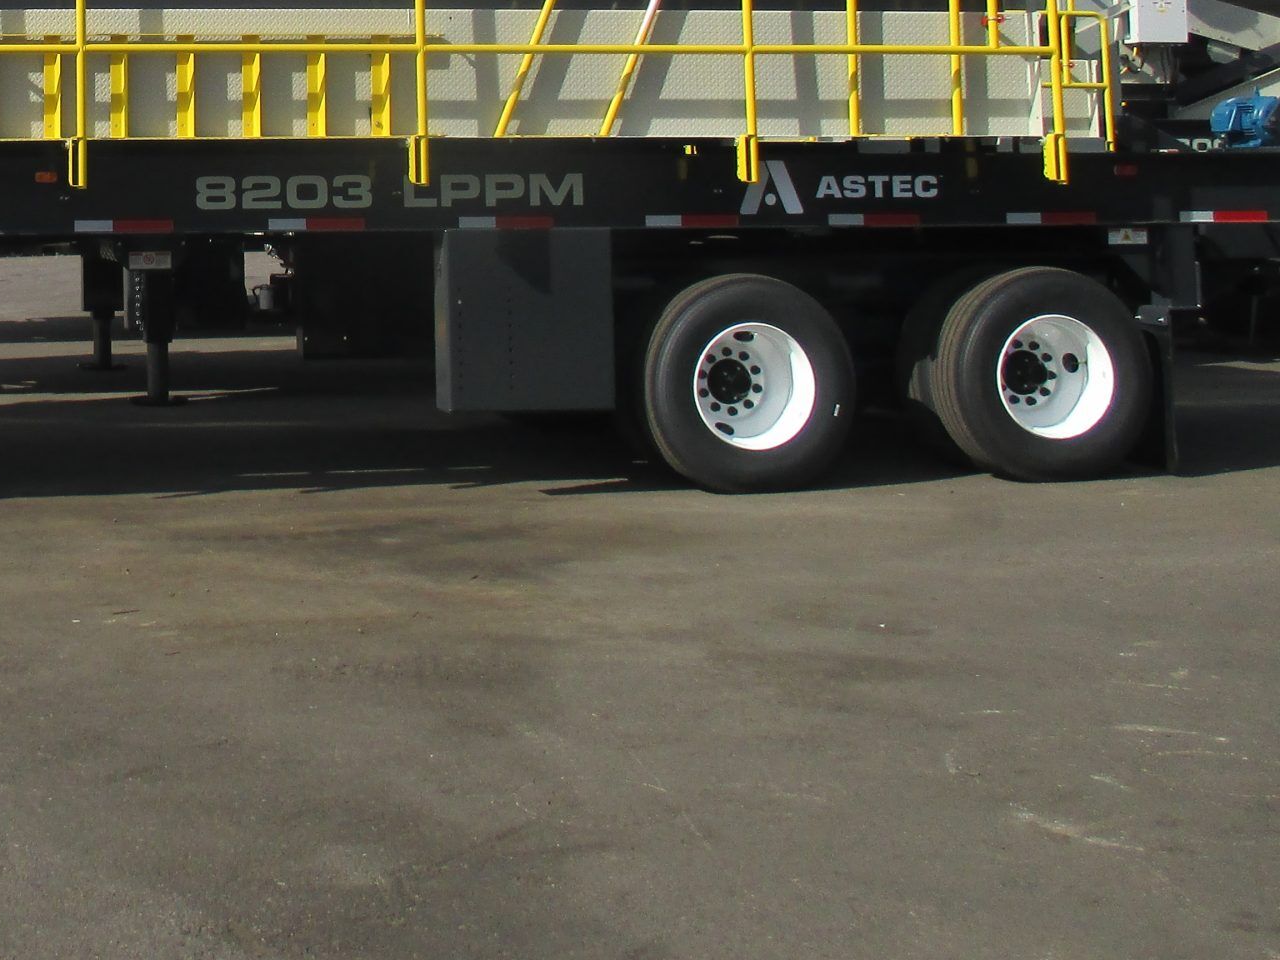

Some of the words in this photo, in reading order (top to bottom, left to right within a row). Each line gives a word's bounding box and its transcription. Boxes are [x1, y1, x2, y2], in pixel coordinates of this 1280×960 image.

[195, 175, 373, 210] 8203
[403, 173, 584, 208] LPPM
[815, 175, 939, 198] ASTEC
